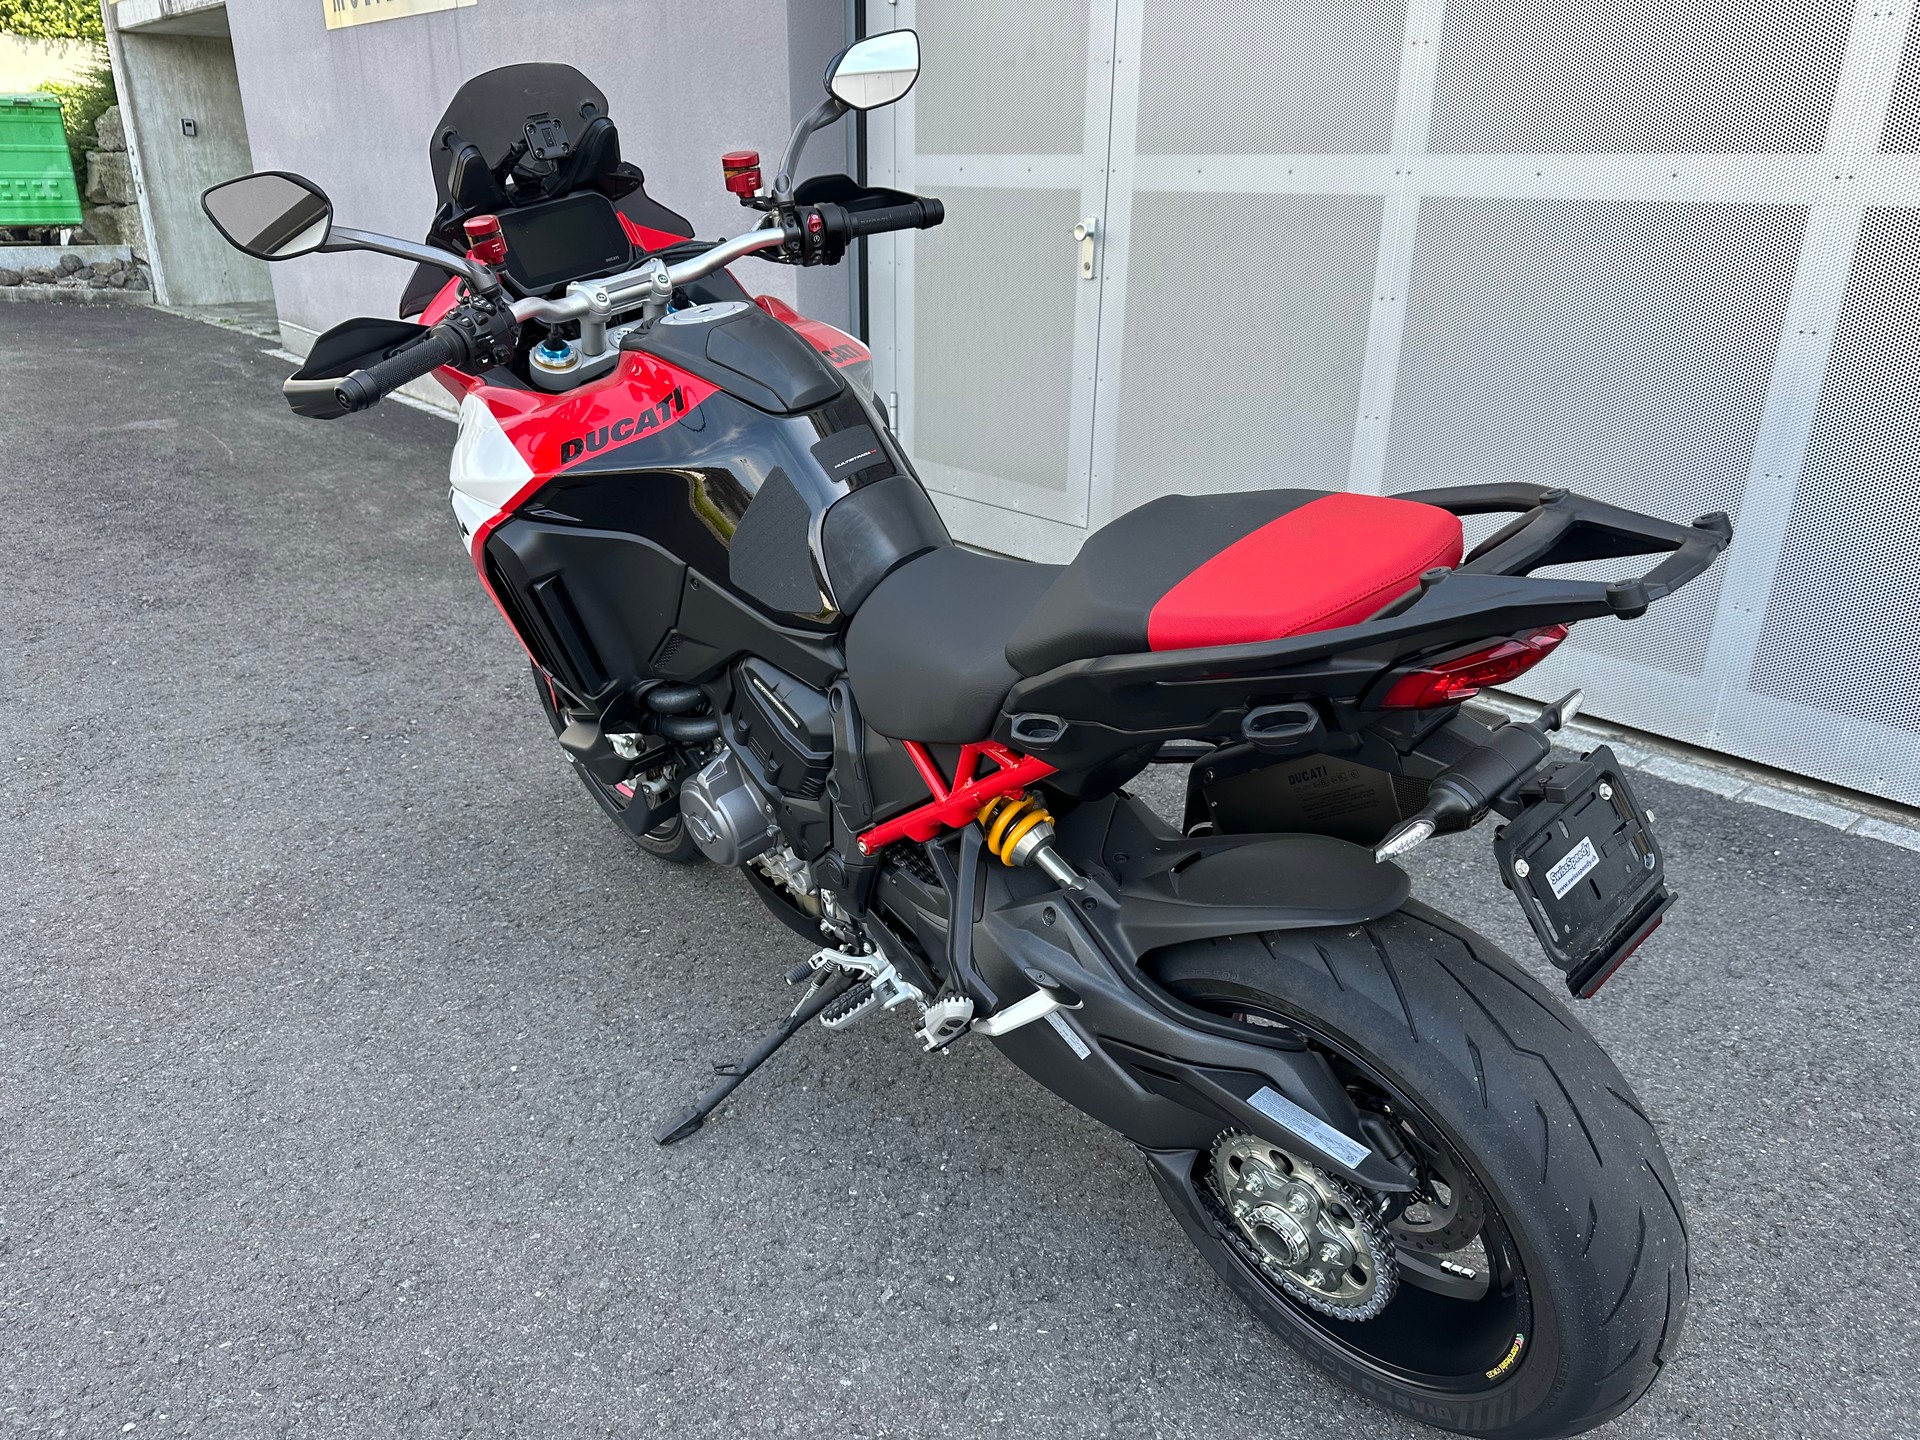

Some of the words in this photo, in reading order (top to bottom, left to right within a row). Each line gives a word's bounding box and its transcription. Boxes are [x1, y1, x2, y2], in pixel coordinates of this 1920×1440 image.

[822, 344, 864, 364] CATI
[561, 385, 685, 466] DUCATI
[1288, 766, 1328, 786] DUCATI
[1550, 842, 1591, 885] SwissSpeedy
